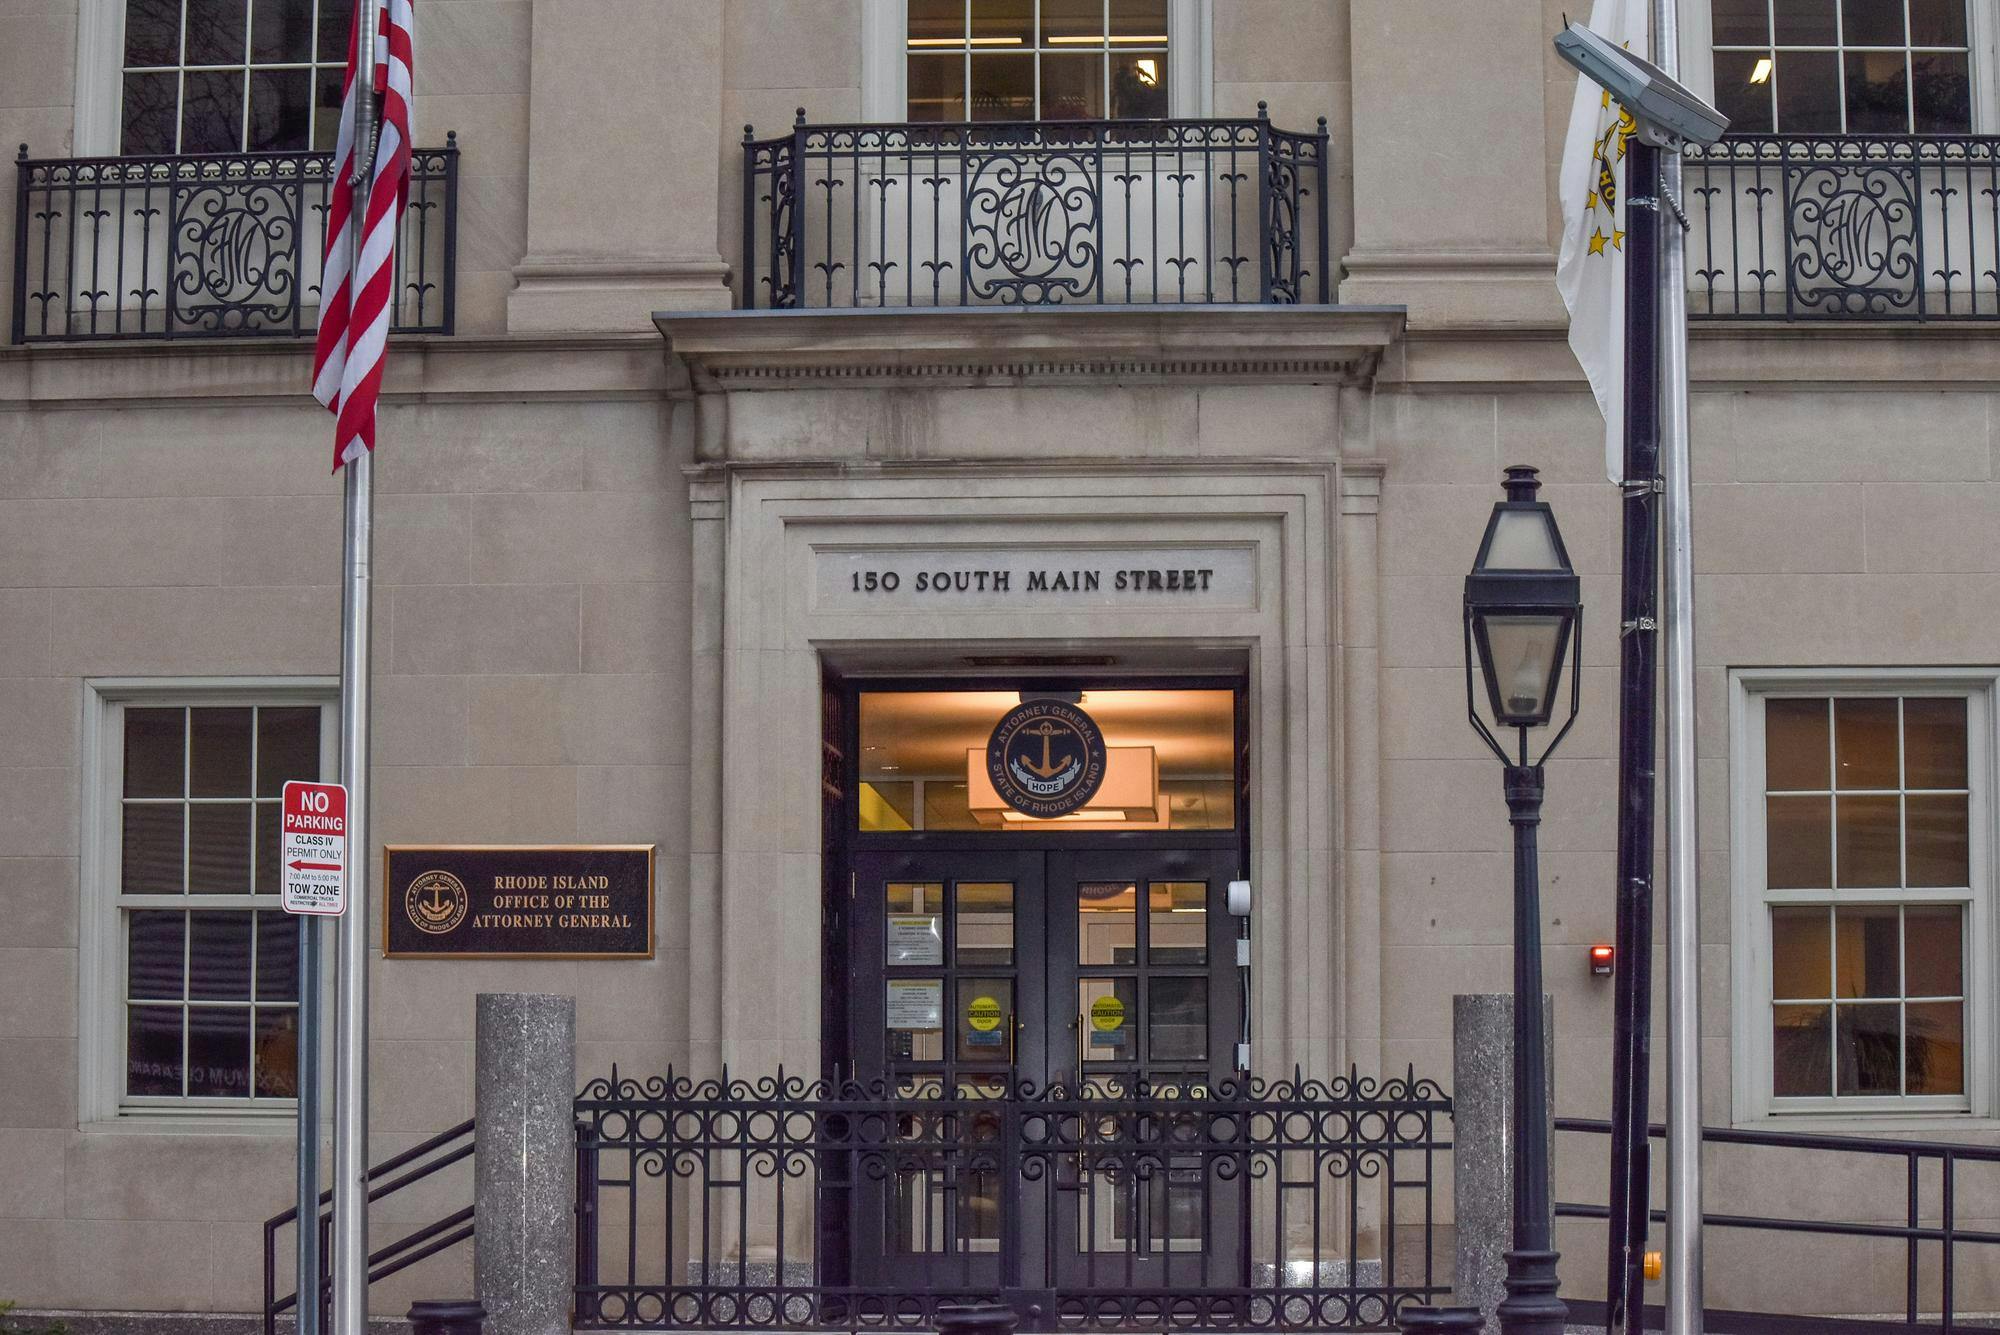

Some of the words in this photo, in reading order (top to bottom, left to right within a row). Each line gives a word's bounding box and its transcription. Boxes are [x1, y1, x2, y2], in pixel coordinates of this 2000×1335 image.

[852, 571, 900, 592] 150
[916, 571, 1010, 592] SOUTH
[1026, 570, 1100, 591] MAIN
[1115, 569, 1213, 591] STREET
[998, 705, 1048, 744] ATTORNEY
[1051, 706, 1095, 744] GENERAL
[993, 764, 1016, 797] STATE
[1014, 796, 1031, 808] OF
[1032, 799, 1074, 812] RHODE
[1073, 763, 1100, 802] ISLAND
[1032, 782, 1059, 791] HOPE
[301, 791, 329, 813] NO
[287, 814, 343, 831] PARKING
[295, 835, 323, 846] CLASS
[325, 837, 333, 846] IV
[287, 847, 317, 858] PERMIT
[319, 849, 342, 860] ONLY
[289, 883, 310, 894] TOW
[313, 884, 340, 896] ZONE
[411, 874, 438, 895] ATTORNEY
[439, 874, 462, 895] GENERAL
[494, 876, 547, 889] RHODE
[553, 876, 609, 889] ISLAND
[493, 895, 549, 908] OFFICE
[554, 895, 575, 908] OF
[579, 895, 610, 908] THE
[472, 914, 554, 928] ATTORNEY
[559, 914, 631, 928] GENERAL
